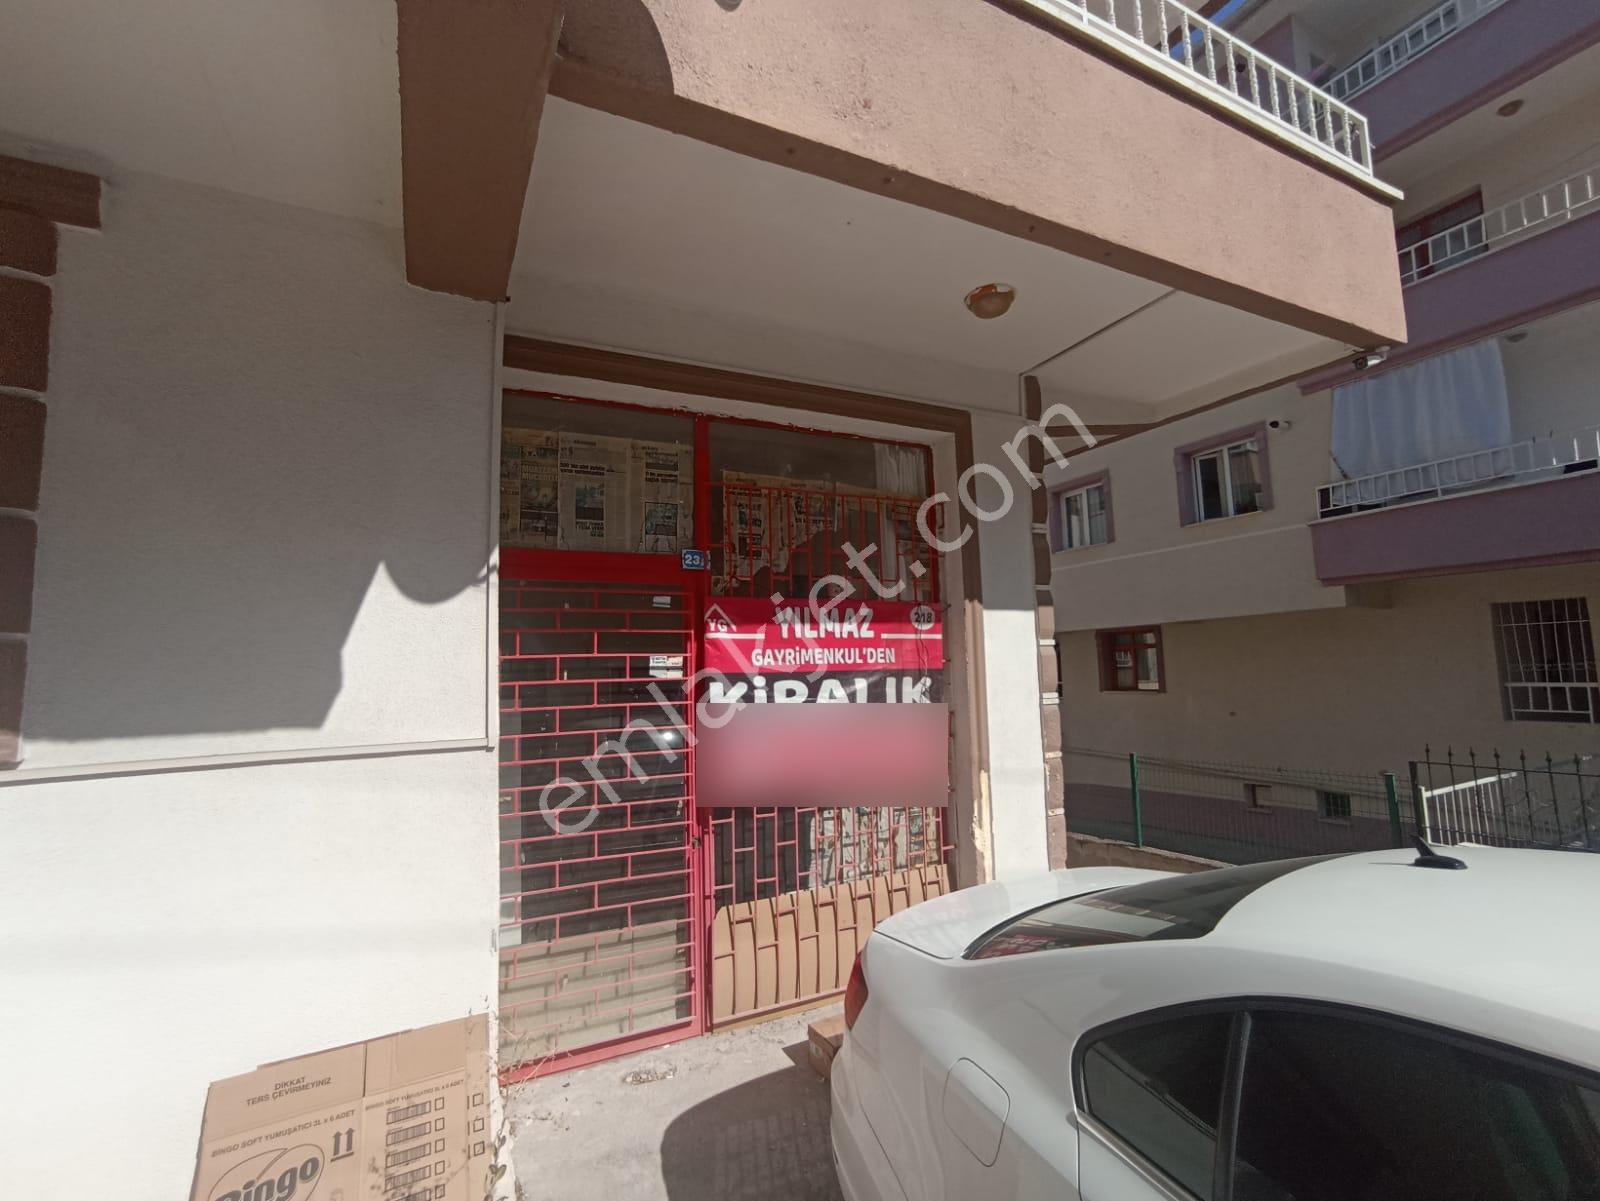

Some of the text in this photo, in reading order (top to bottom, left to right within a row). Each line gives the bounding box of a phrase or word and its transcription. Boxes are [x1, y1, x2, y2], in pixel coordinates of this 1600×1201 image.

[707, 618, 728, 632] YG
[776, 606, 875, 639] YILMAZ
[913, 611, 933, 624] 218
[751, 646, 896, 667] GAYRİMENKUL'DEN
